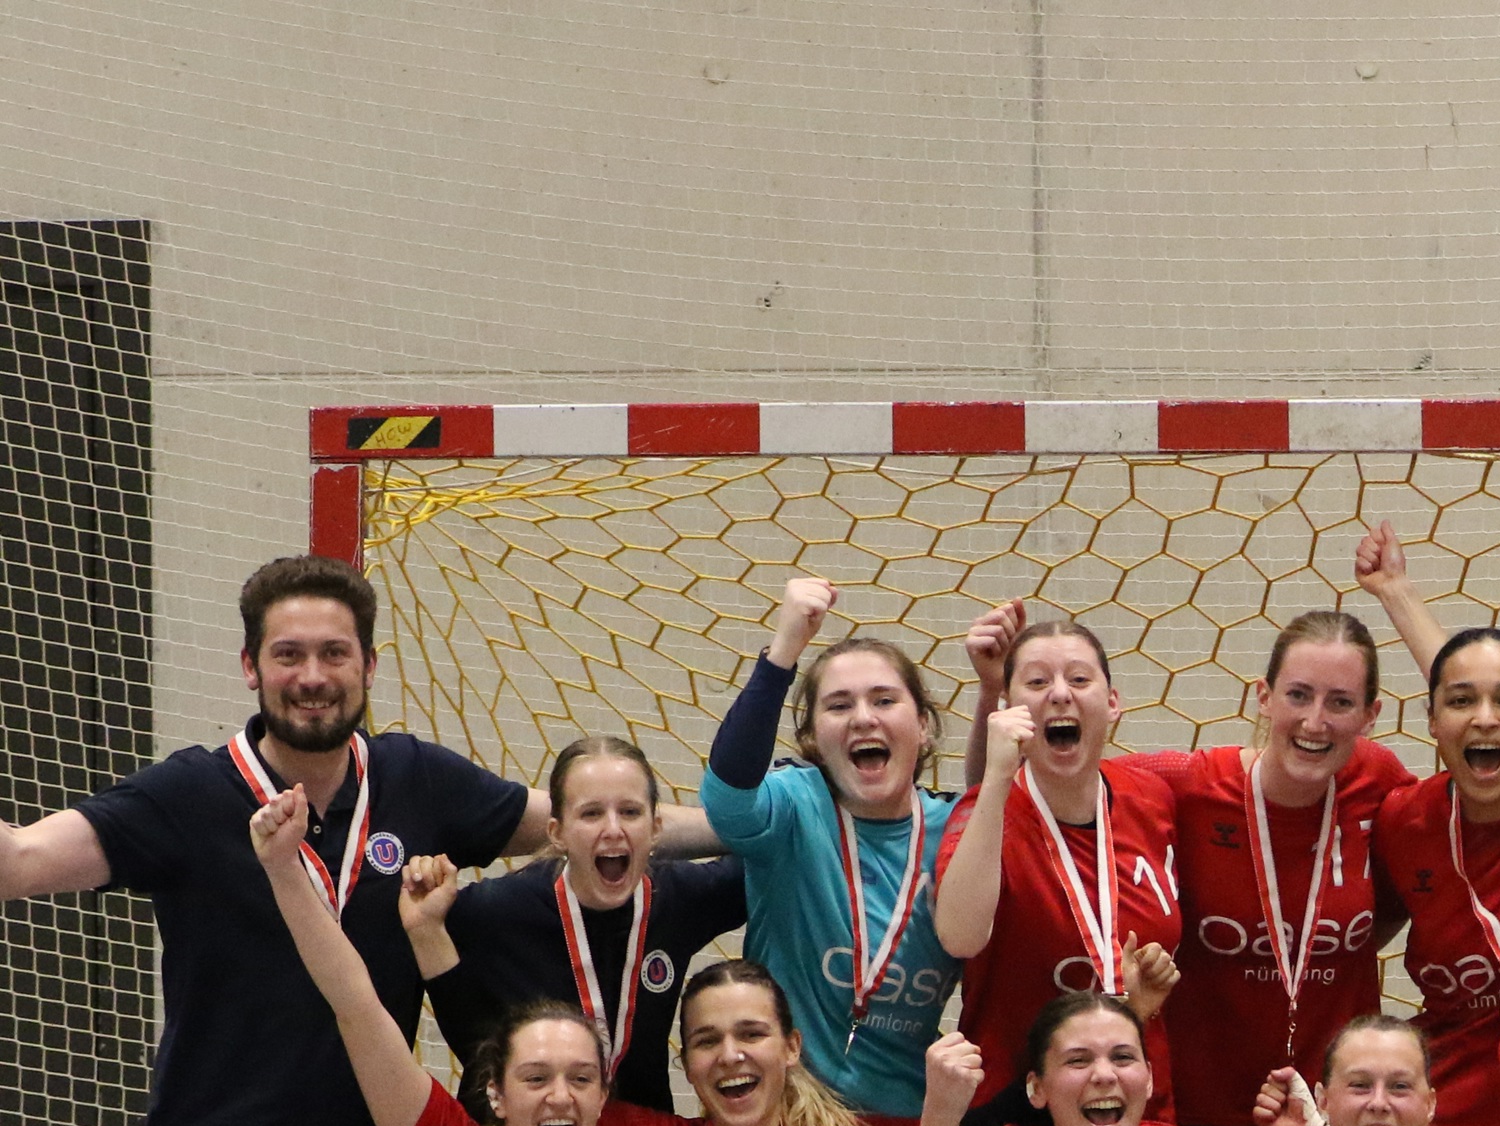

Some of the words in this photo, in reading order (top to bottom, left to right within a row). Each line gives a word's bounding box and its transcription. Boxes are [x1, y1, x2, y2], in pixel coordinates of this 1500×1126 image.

[375, 842, 395, 864] U
[1199, 910, 1374, 956] oase
[650, 960, 666, 982] U
